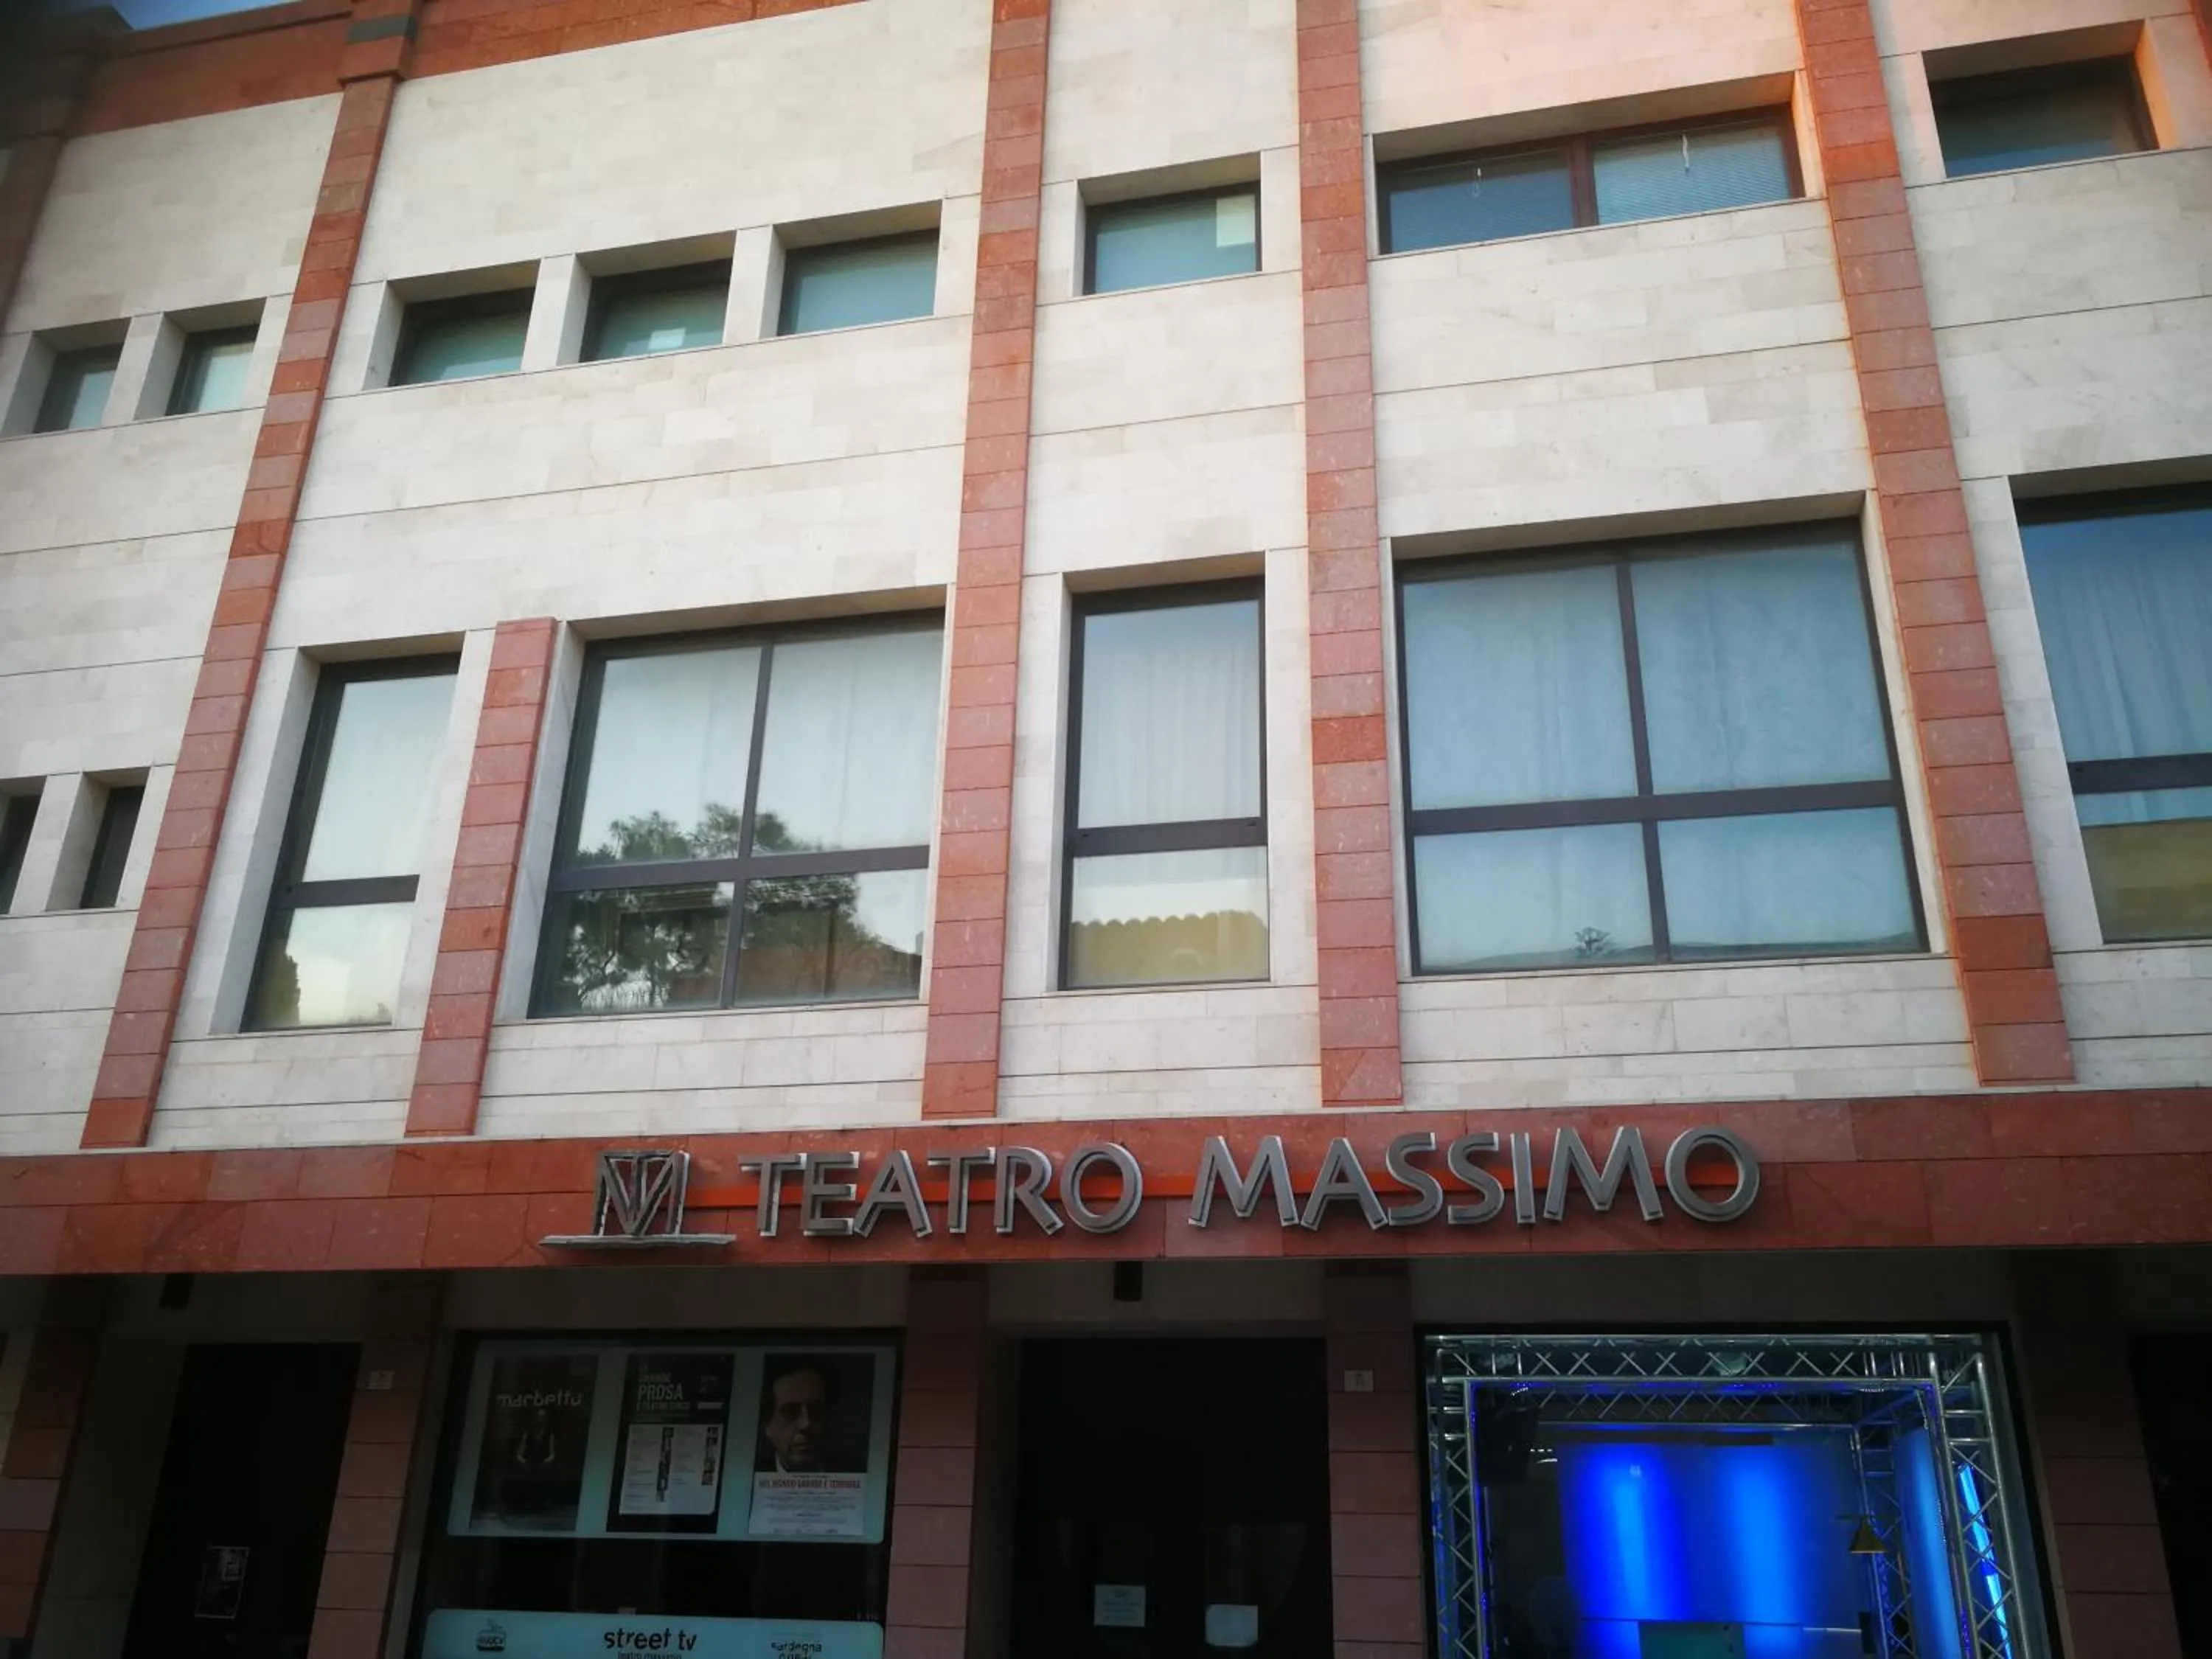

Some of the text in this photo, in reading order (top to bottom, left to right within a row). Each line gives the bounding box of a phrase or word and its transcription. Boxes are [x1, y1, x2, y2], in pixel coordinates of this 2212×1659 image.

[741, 1125, 1760, 1238] TEATRO MASSIMO
[638, 1382, 684, 1400] PROSA
[604, 1628, 697, 1651] street tv
